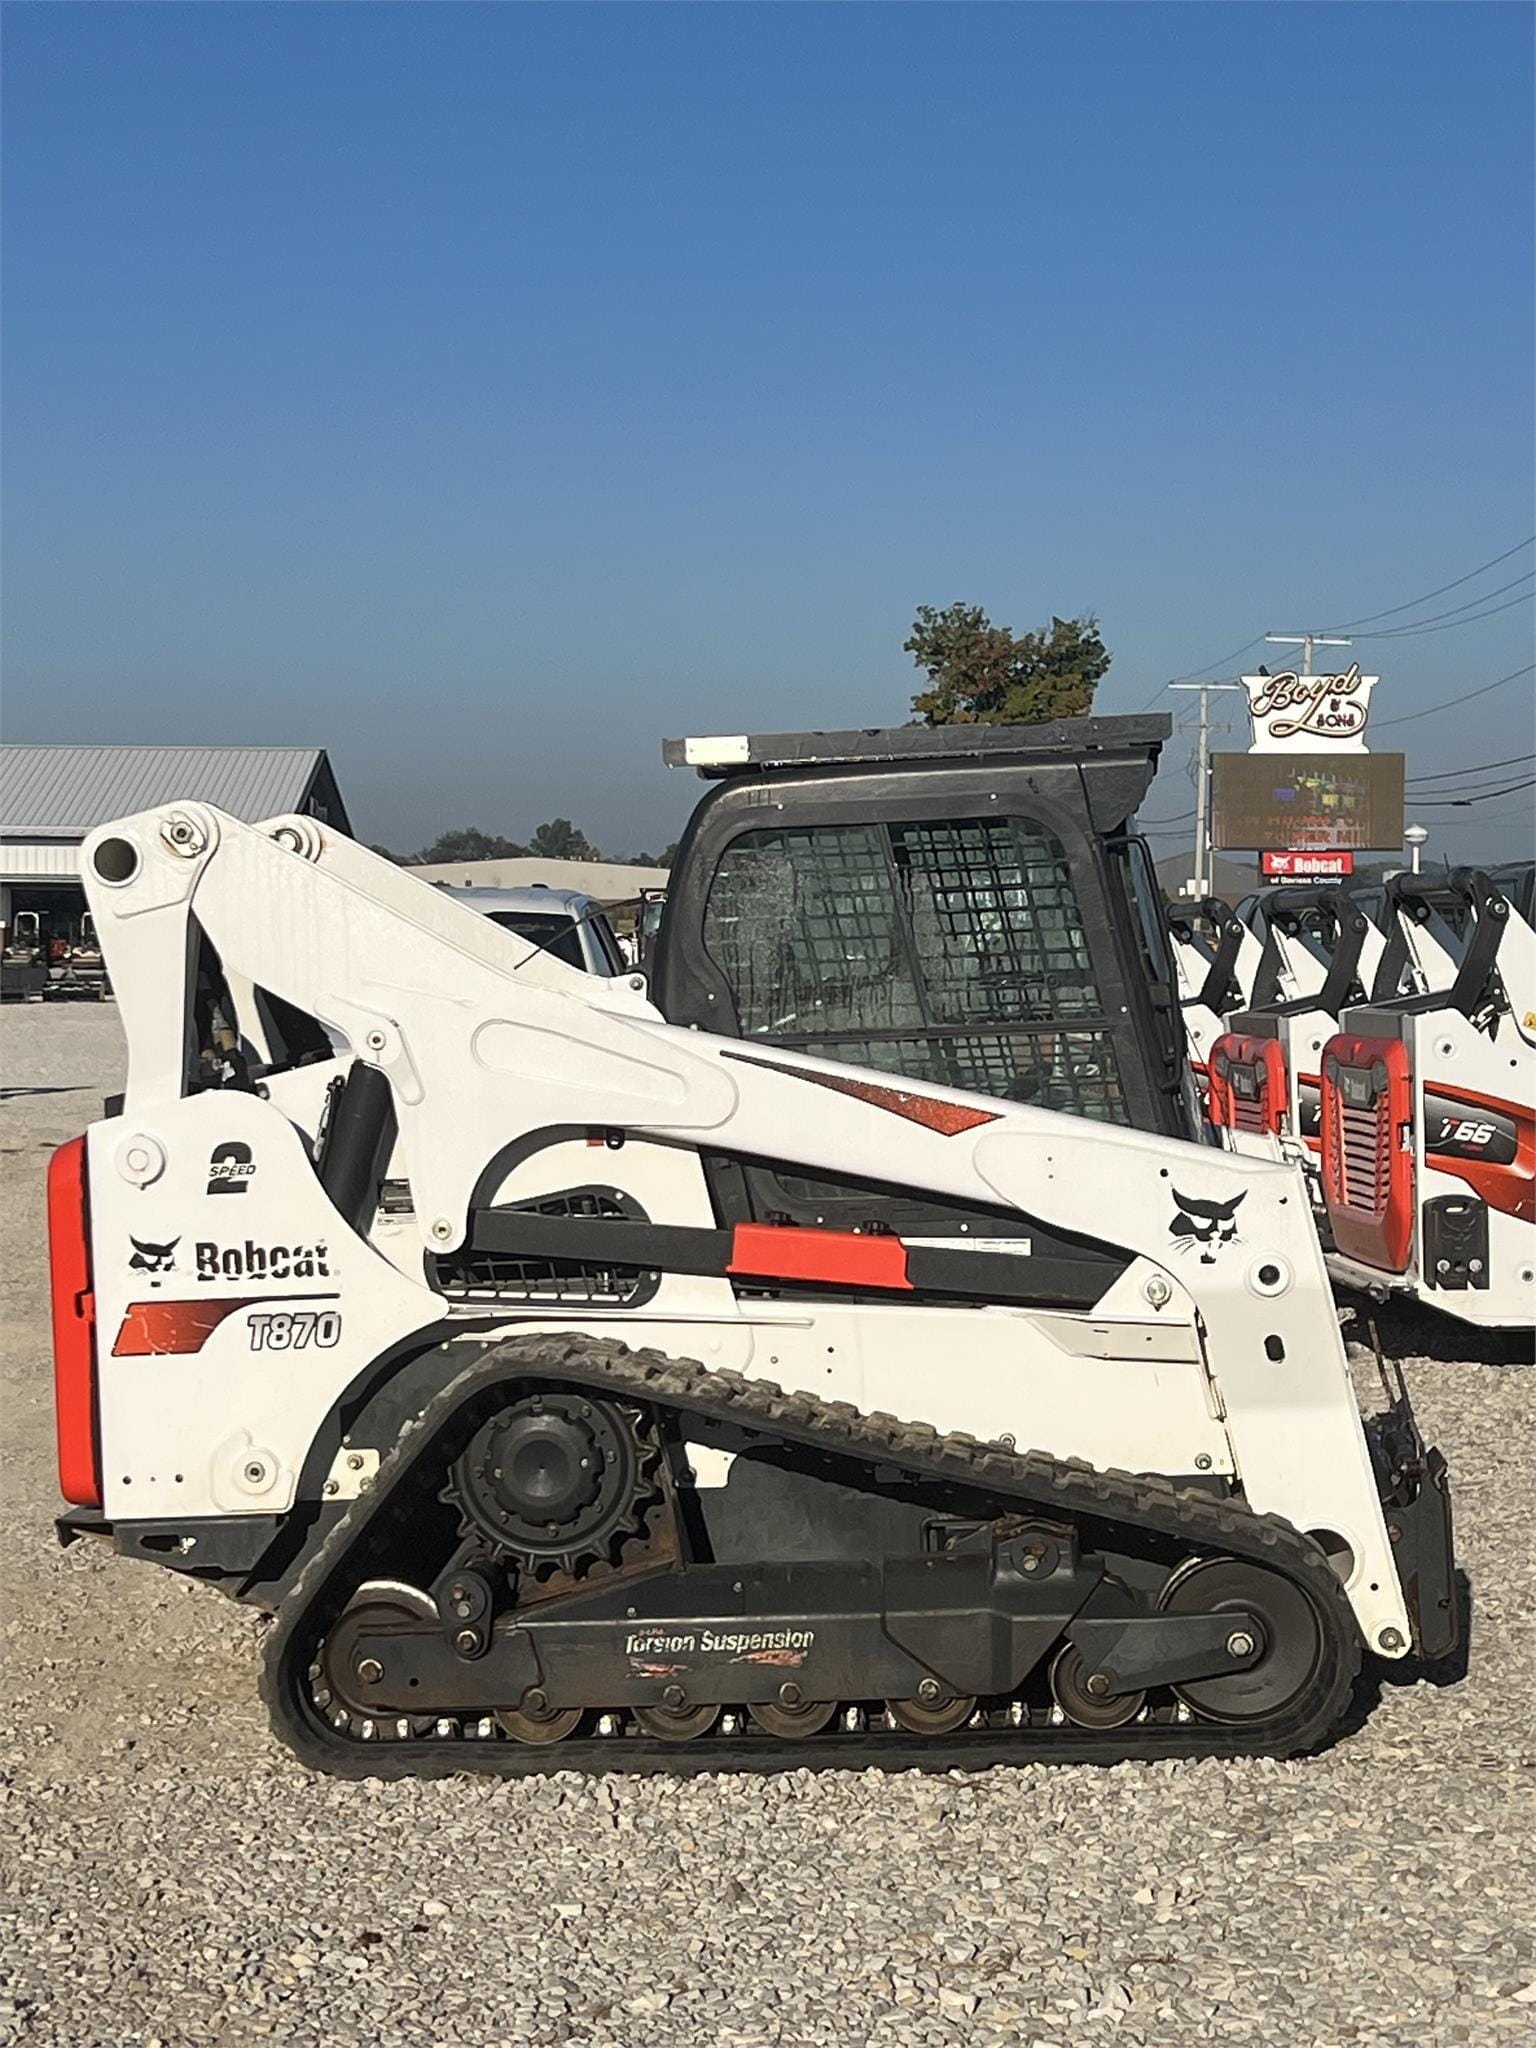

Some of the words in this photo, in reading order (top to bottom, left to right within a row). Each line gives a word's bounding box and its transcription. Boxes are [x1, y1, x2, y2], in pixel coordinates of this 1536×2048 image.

[1250, 661, 1368, 738] Boyd
[1316, 714, 1355, 727] SONS
[1294, 857, 1343, 873] Bobcat
[1440, 1117, 1497, 1144] T66
[207, 1141, 253, 1195] 2
[208, 1164, 257, 1178] SPEED
[195, 1240, 330, 1281] Bobcat
[247, 1311, 342, 1351] T870
[625, 1634, 696, 1655] Torsion
[701, 1628, 815, 1653] Suspension
